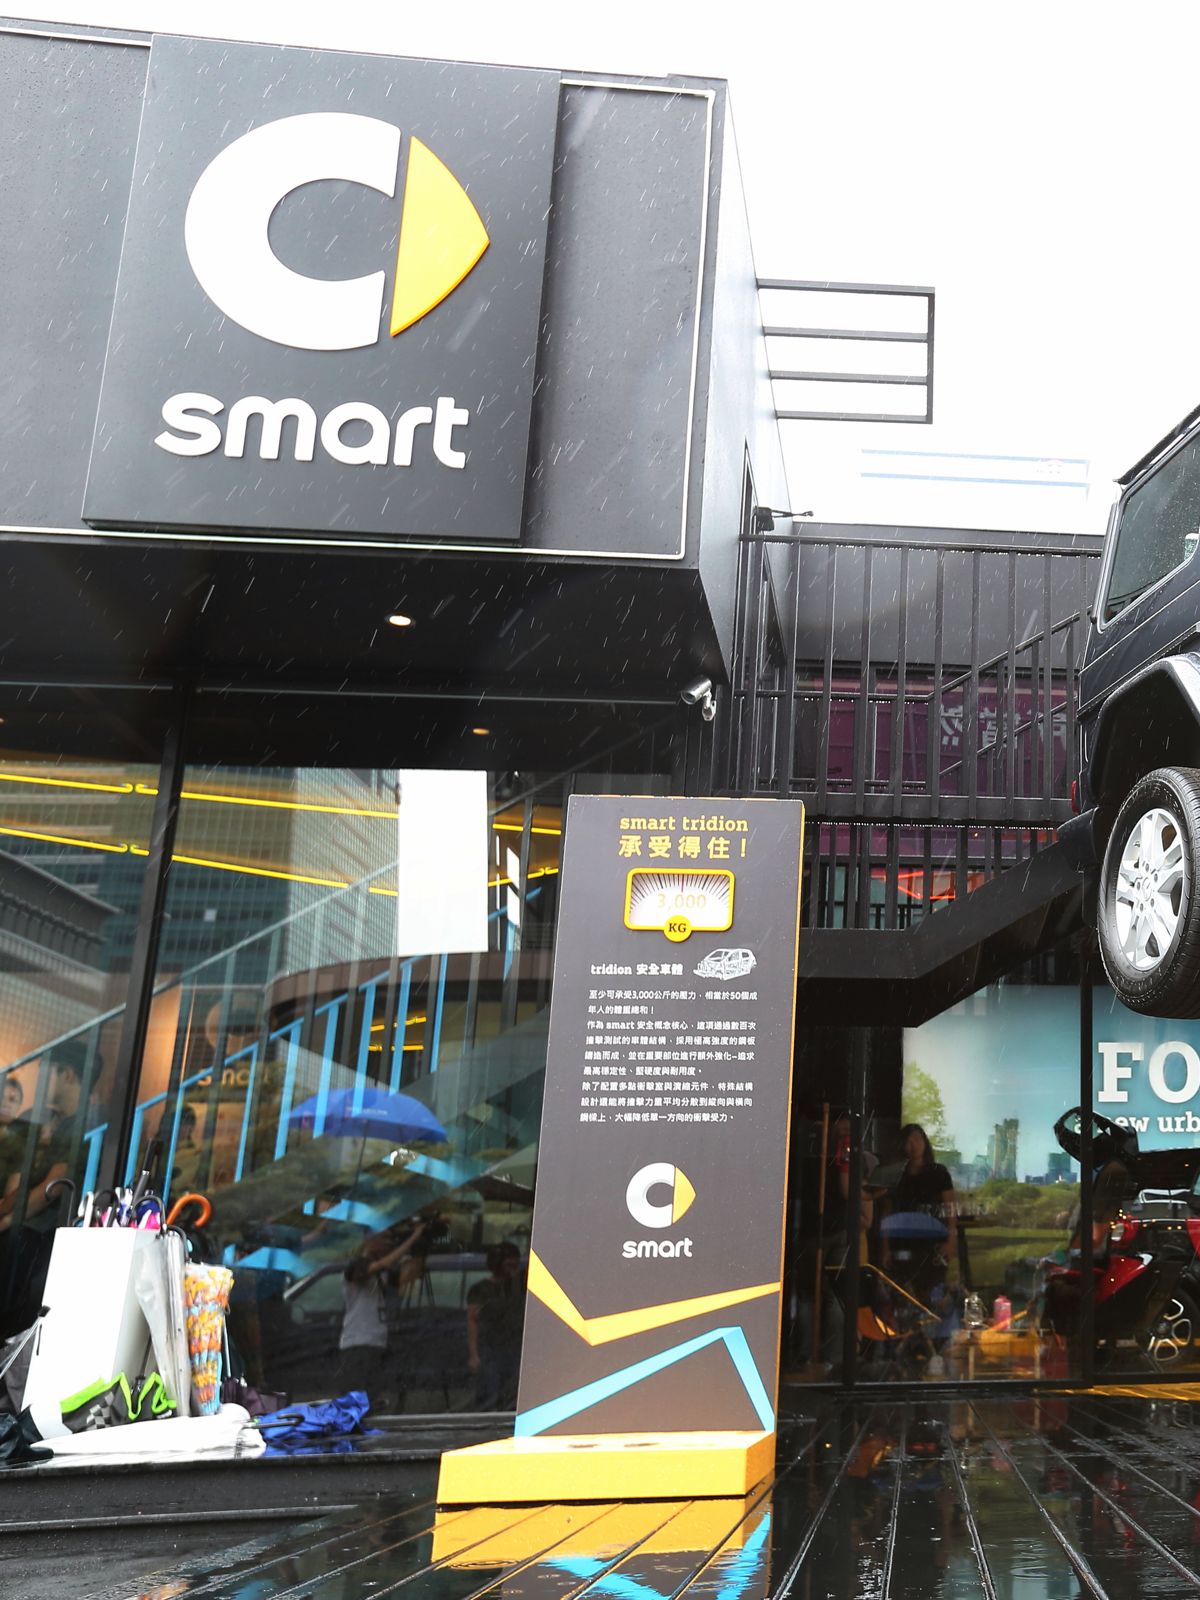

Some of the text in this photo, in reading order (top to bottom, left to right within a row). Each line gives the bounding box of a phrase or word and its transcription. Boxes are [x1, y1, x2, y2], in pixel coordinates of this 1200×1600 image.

[154, 391, 470, 469] smart
[619, 815, 749, 832] smart tridion
[618, 835, 747, 859] 承受得住！
[657, 893, 707, 912] 3,000
[668, 923, 687, 933] KG
[590, 963, 684, 976] tridion 安全車體
[606, 1021, 635, 1030] smart
[1097, 1115, 1150, 1133] ew
[622, 1237, 693, 1259] smart
